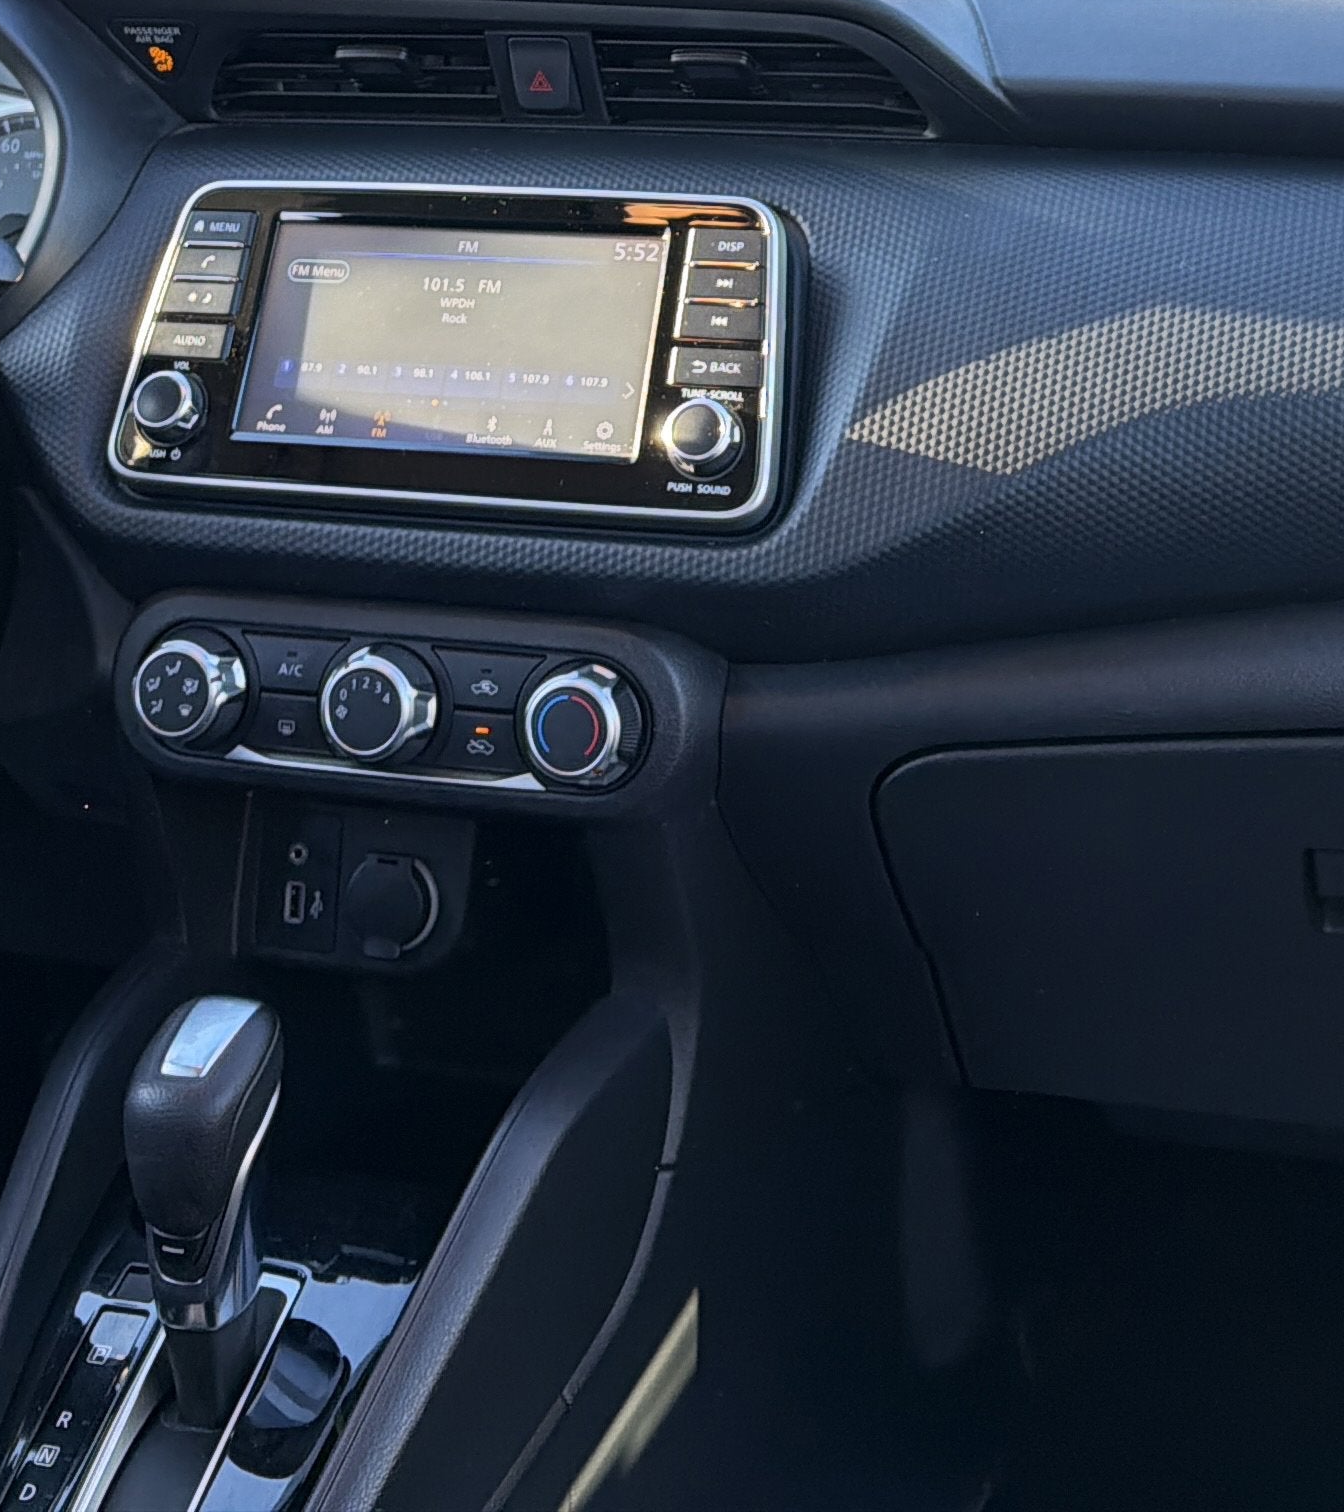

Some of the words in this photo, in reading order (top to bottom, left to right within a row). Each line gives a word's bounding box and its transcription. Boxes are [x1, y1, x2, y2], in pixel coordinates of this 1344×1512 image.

[0, 138, 20, 153] 60
[209, 220, 241, 233] MENU
[457, 240, 480, 253] FM
[613, 241, 659, 263] 5:52
[717, 240, 745, 253] DISP
[291, 264, 310, 276] FM
[312, 265, 345, 278] Menu
[422, 276, 465, 293] 101.5
[477, 279, 502, 294] FM
[440, 296, 476, 309] WPDH
[441, 312, 468, 325] Rock
[172, 334, 207, 346] AUDIO
[173, 361, 191, 371] VOL
[709, 361, 742, 375] BACK
[256, 421, 286, 433] Phone
[315, 424, 335, 435] AM
[371, 427, 387, 438] FM
[465, 433, 513, 446] Bluetooth
[533, 437, 557, 449] AUX
[146, 448, 167, 459] USH
[583, 440, 622, 454] Settings
[666, 481, 693, 493] PUSH
[696, 483, 732, 496] SOUND
[277, 662, 304, 677] A/C
[362, 676, 371, 689] 2
[374, 680, 383, 694] 3
[382, 691, 392, 705] 4
[56, 1410, 73, 1429] R
[18, 1482, 37, 1501] D
